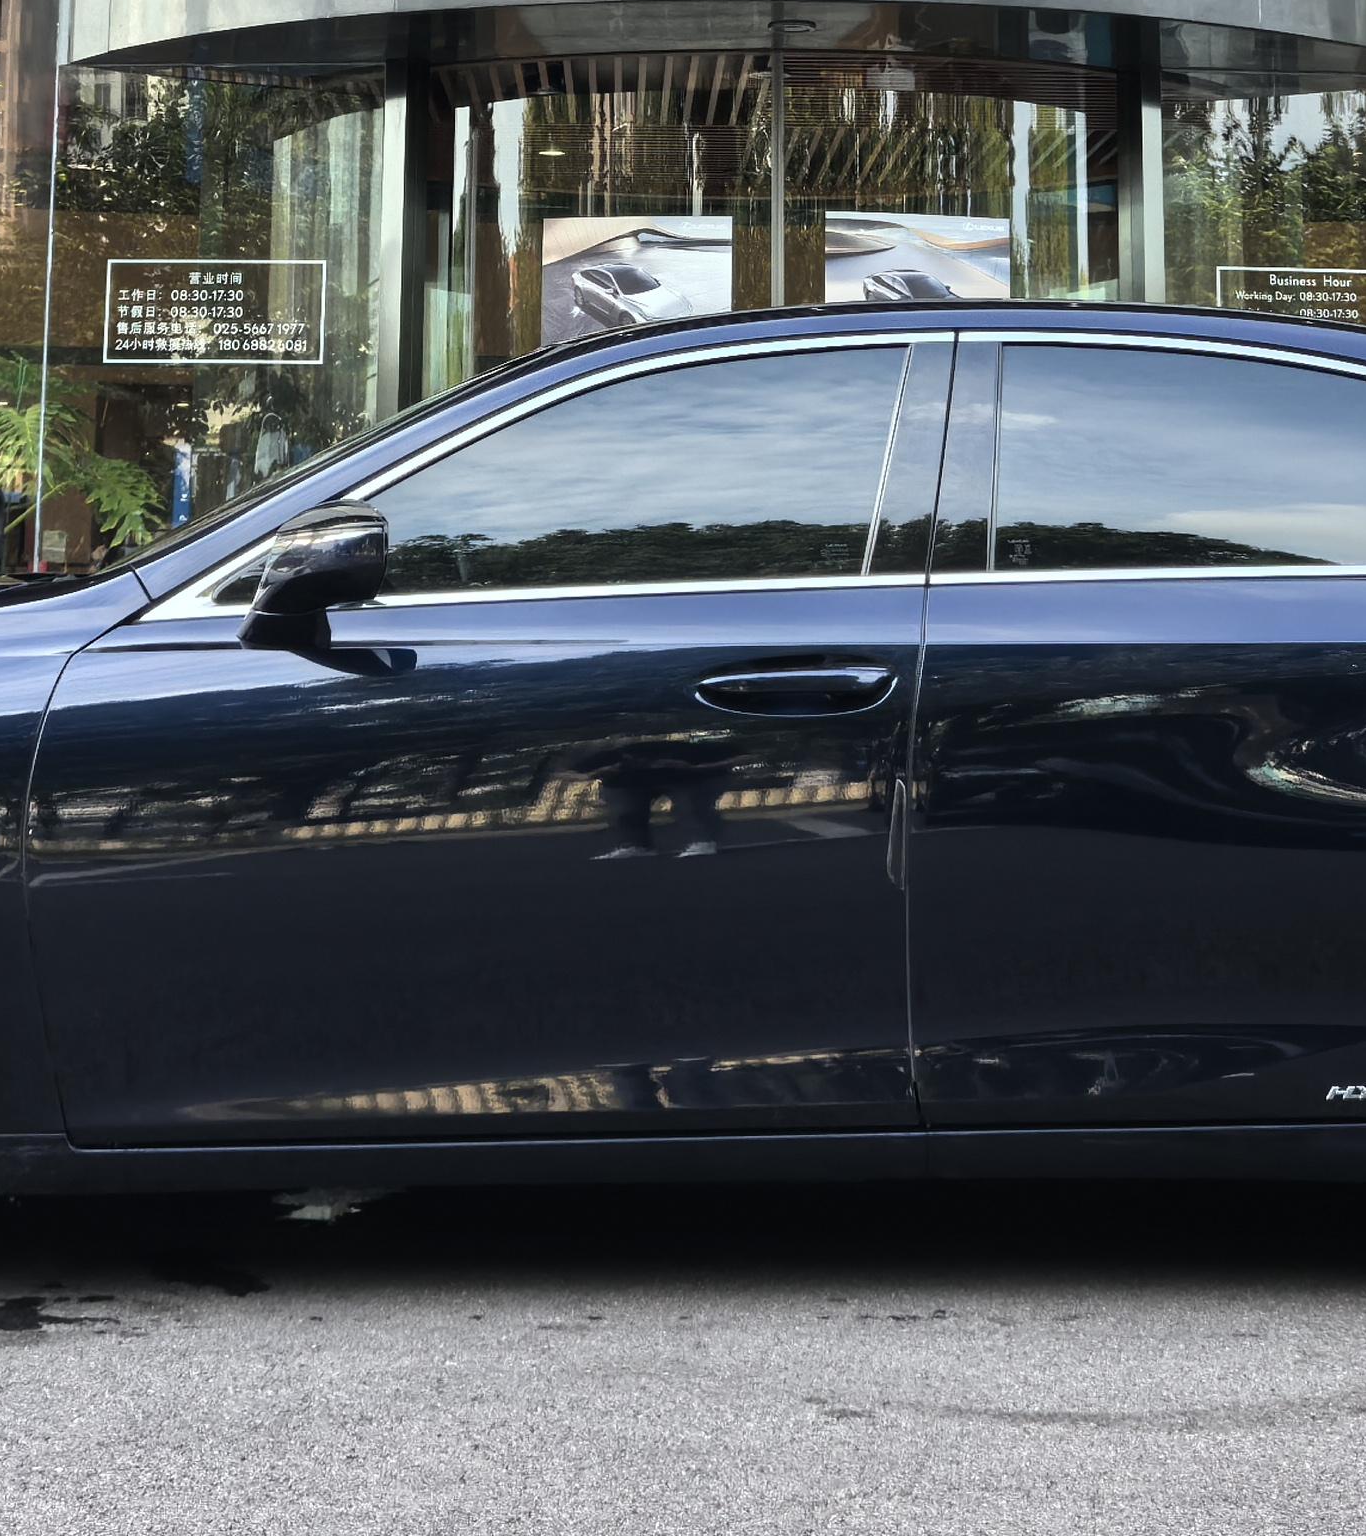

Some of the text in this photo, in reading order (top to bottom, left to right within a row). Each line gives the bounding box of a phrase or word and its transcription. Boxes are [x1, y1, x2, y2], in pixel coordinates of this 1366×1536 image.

[189, 271, 243, 285] 营业时间
[1269, 273, 1353, 288] Business Hour
[171, 289, 244, 302] 08:30-17:30
[1236, 290, 1357, 303] Working Day: 08:30-17:30
